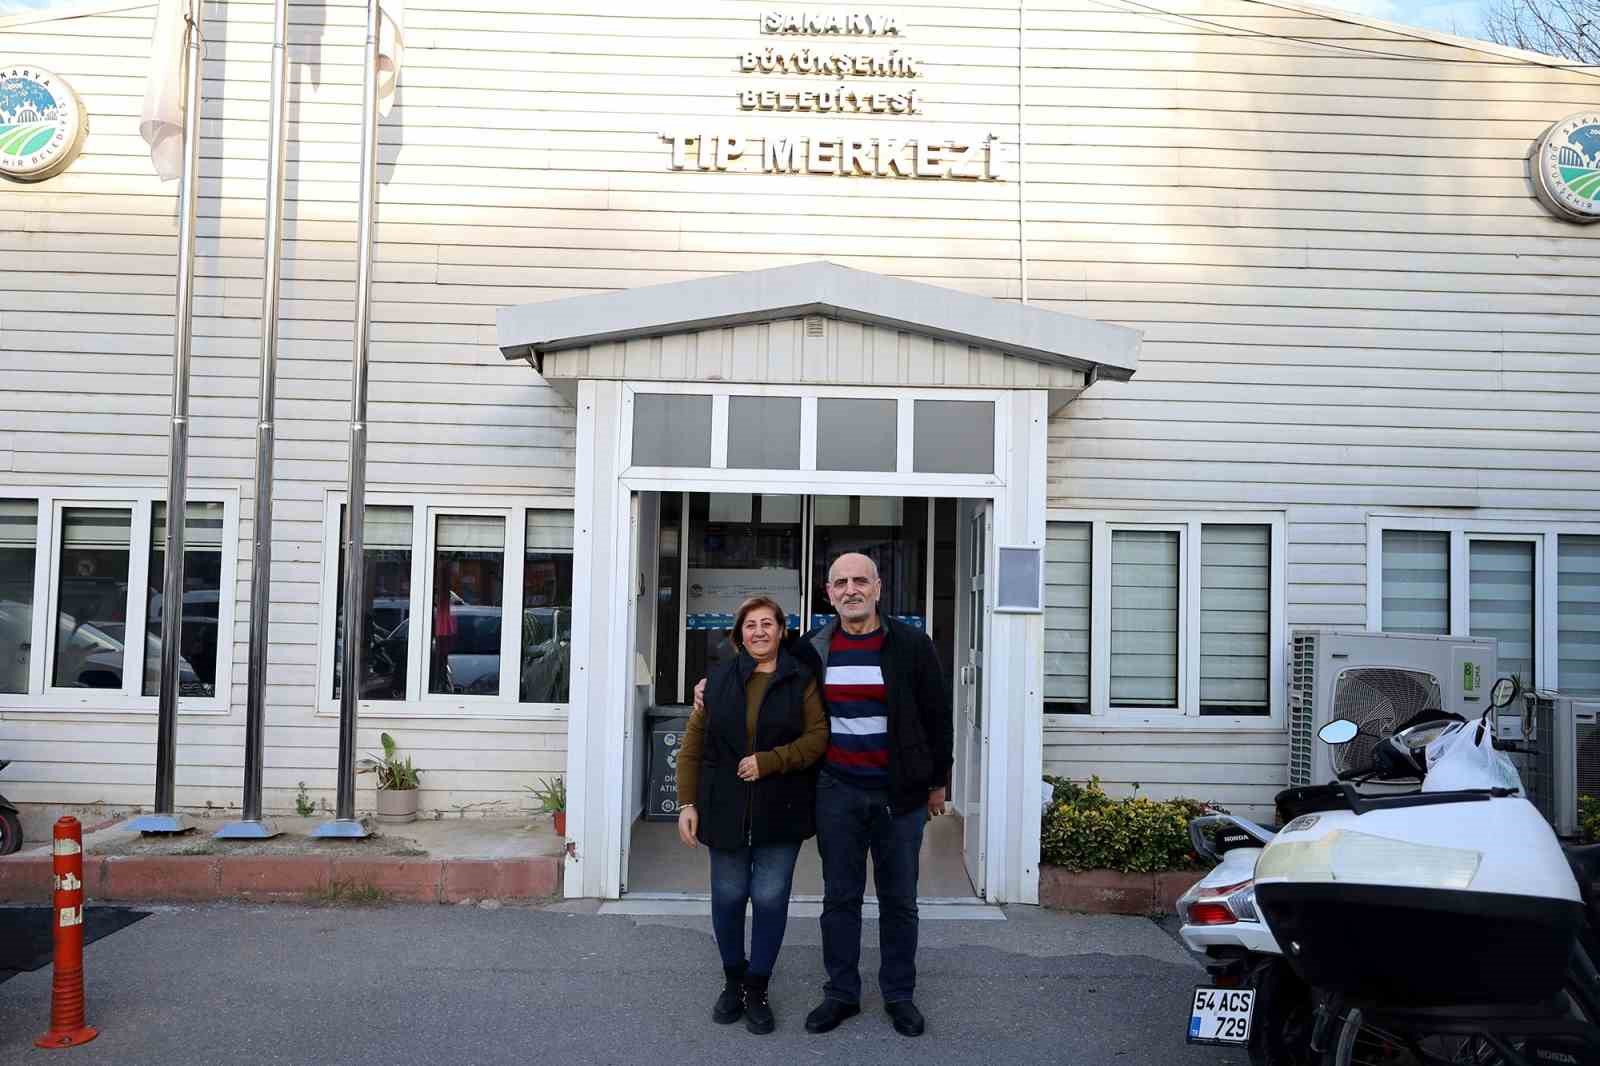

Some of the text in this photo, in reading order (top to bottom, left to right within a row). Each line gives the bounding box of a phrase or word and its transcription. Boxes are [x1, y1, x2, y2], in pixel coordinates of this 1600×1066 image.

[761, 9, 901, 36] SAKARYA
[741, 46, 917, 79] BÜYÜKŞEHİR
[741, 84, 917, 114] BELEDİYESİ
[663, 130, 1001, 180] TIP MERKEZİ
[1224, 834, 1249, 842] HONDA
[1196, 992, 1251, 1012] 54 ACS
[1216, 1017, 1247, 1037] 729
